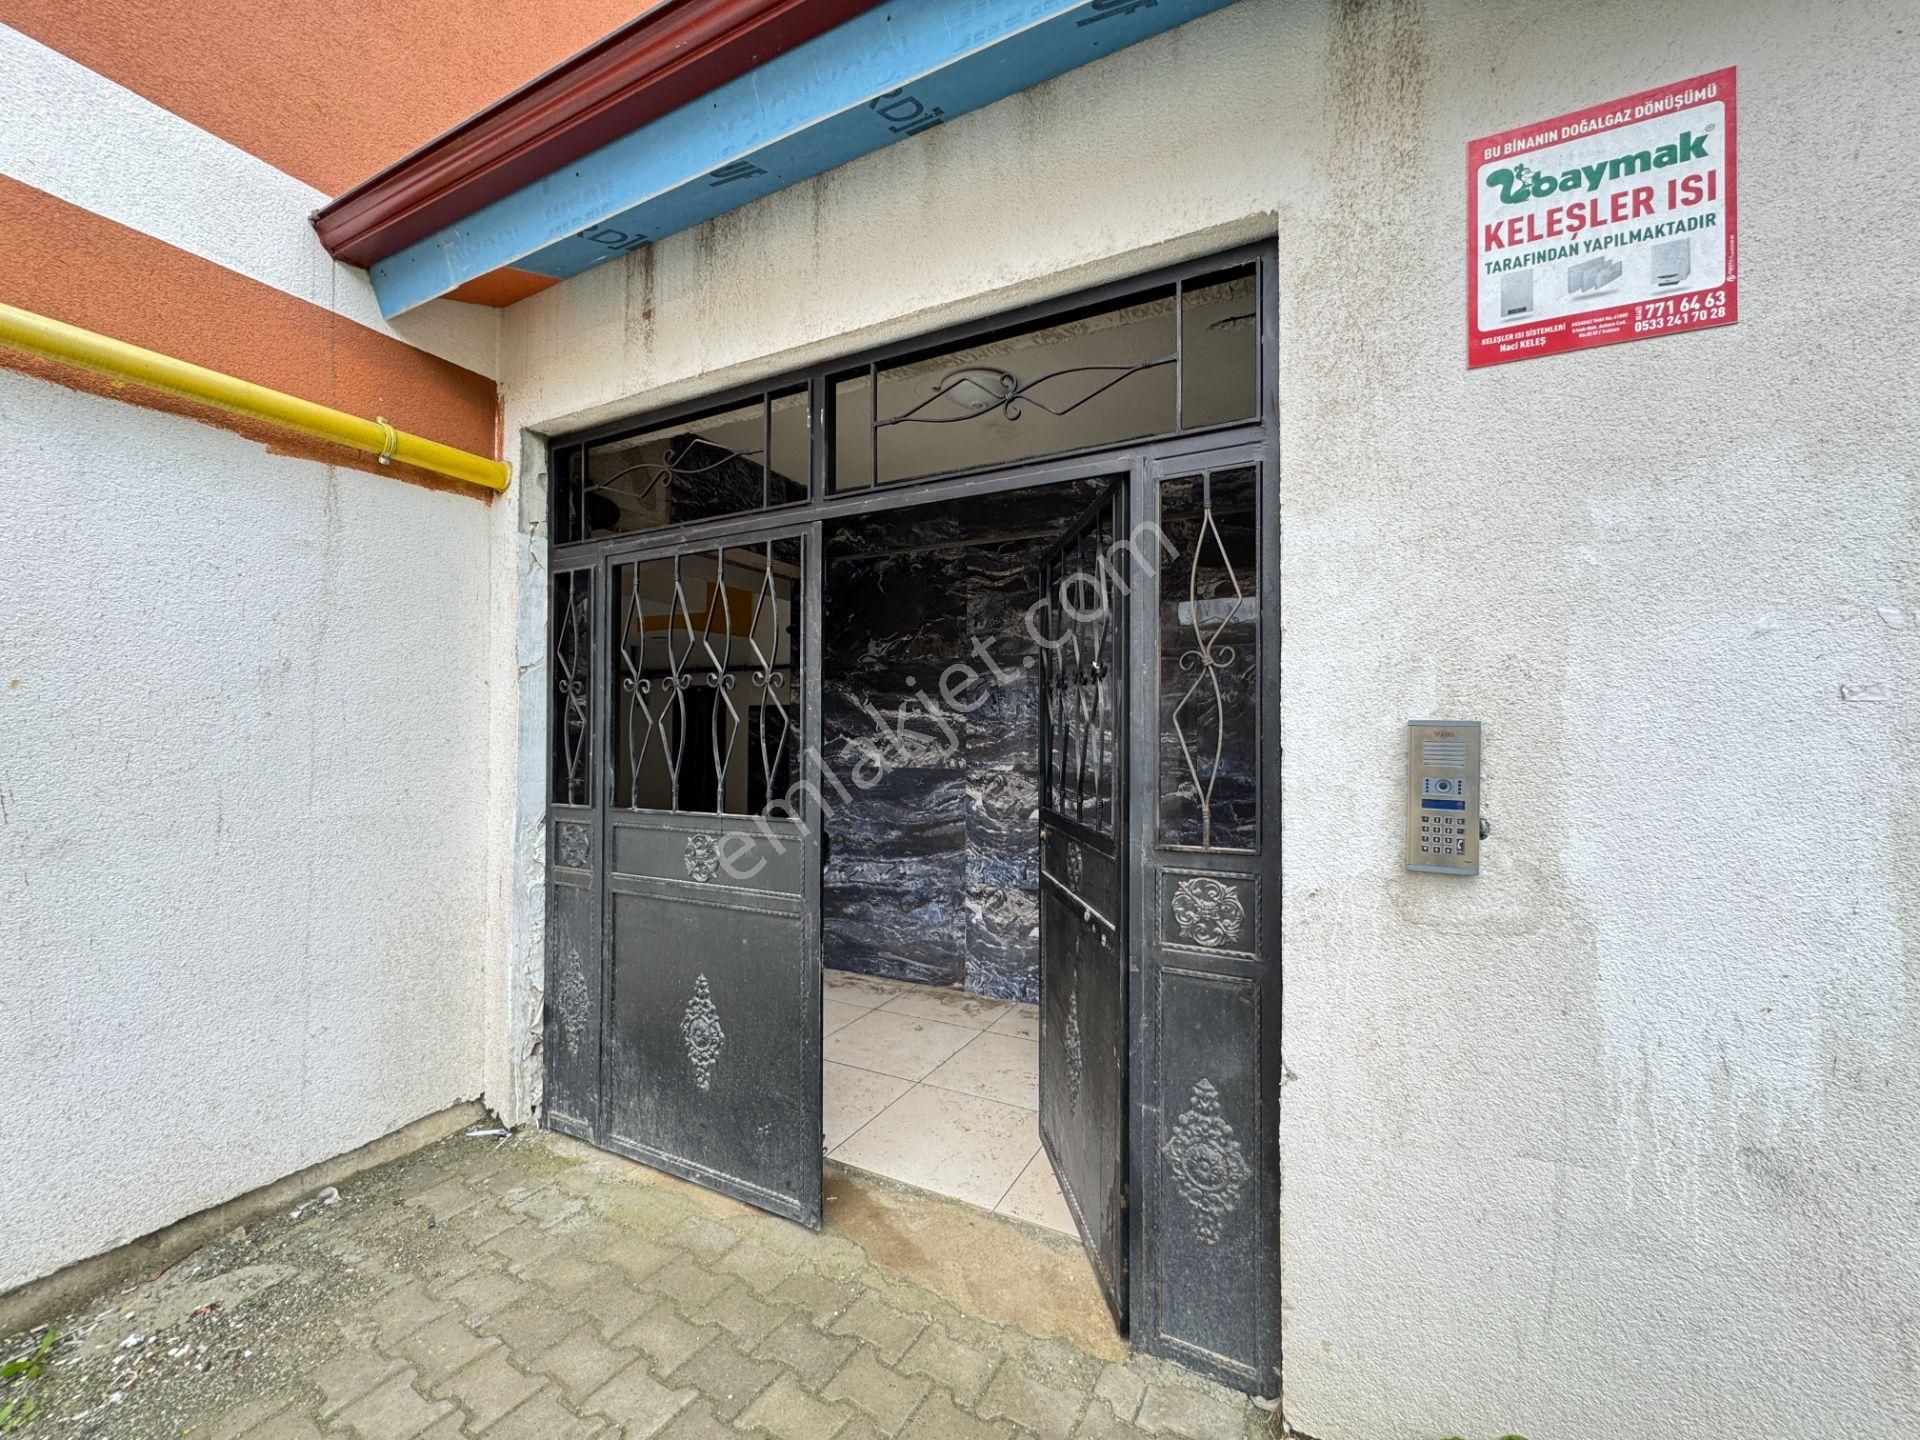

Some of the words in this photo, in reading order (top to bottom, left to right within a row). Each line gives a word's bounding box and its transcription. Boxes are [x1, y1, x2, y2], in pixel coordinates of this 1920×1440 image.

[1484, 145, 1501, 160] BU
[1504, 129, 1558, 155] BİNANIN
[1561, 109, 1631, 139] DOĞALGAZ
[1635, 82, 1717, 118] DÖNÜŞÜMÜ
[1531, 131, 1709, 198] baymak
[1484, 185, 1655, 252] KELEŞLER
[1668, 169, 1716, 210] ISI
[1485, 242, 1579, 275] TARAFINDAN
[1583, 212, 1716, 253] YAPILMAKTADIR
[1635, 318, 1664, 332] 0533
[1666, 313, 1688, 327] 241
[1692, 310, 1707, 322] 70
[1710, 306, 1726, 319] 28
[1645, 299, 1674, 319] 771
[1680, 295, 1701, 312] 64
[1704, 290, 1726, 307] 63
[1481, 333, 1514, 345] KELEŞLER
[1514, 332, 1525, 340] ISI
[1520, 337, 1546, 348] KELEŞ
